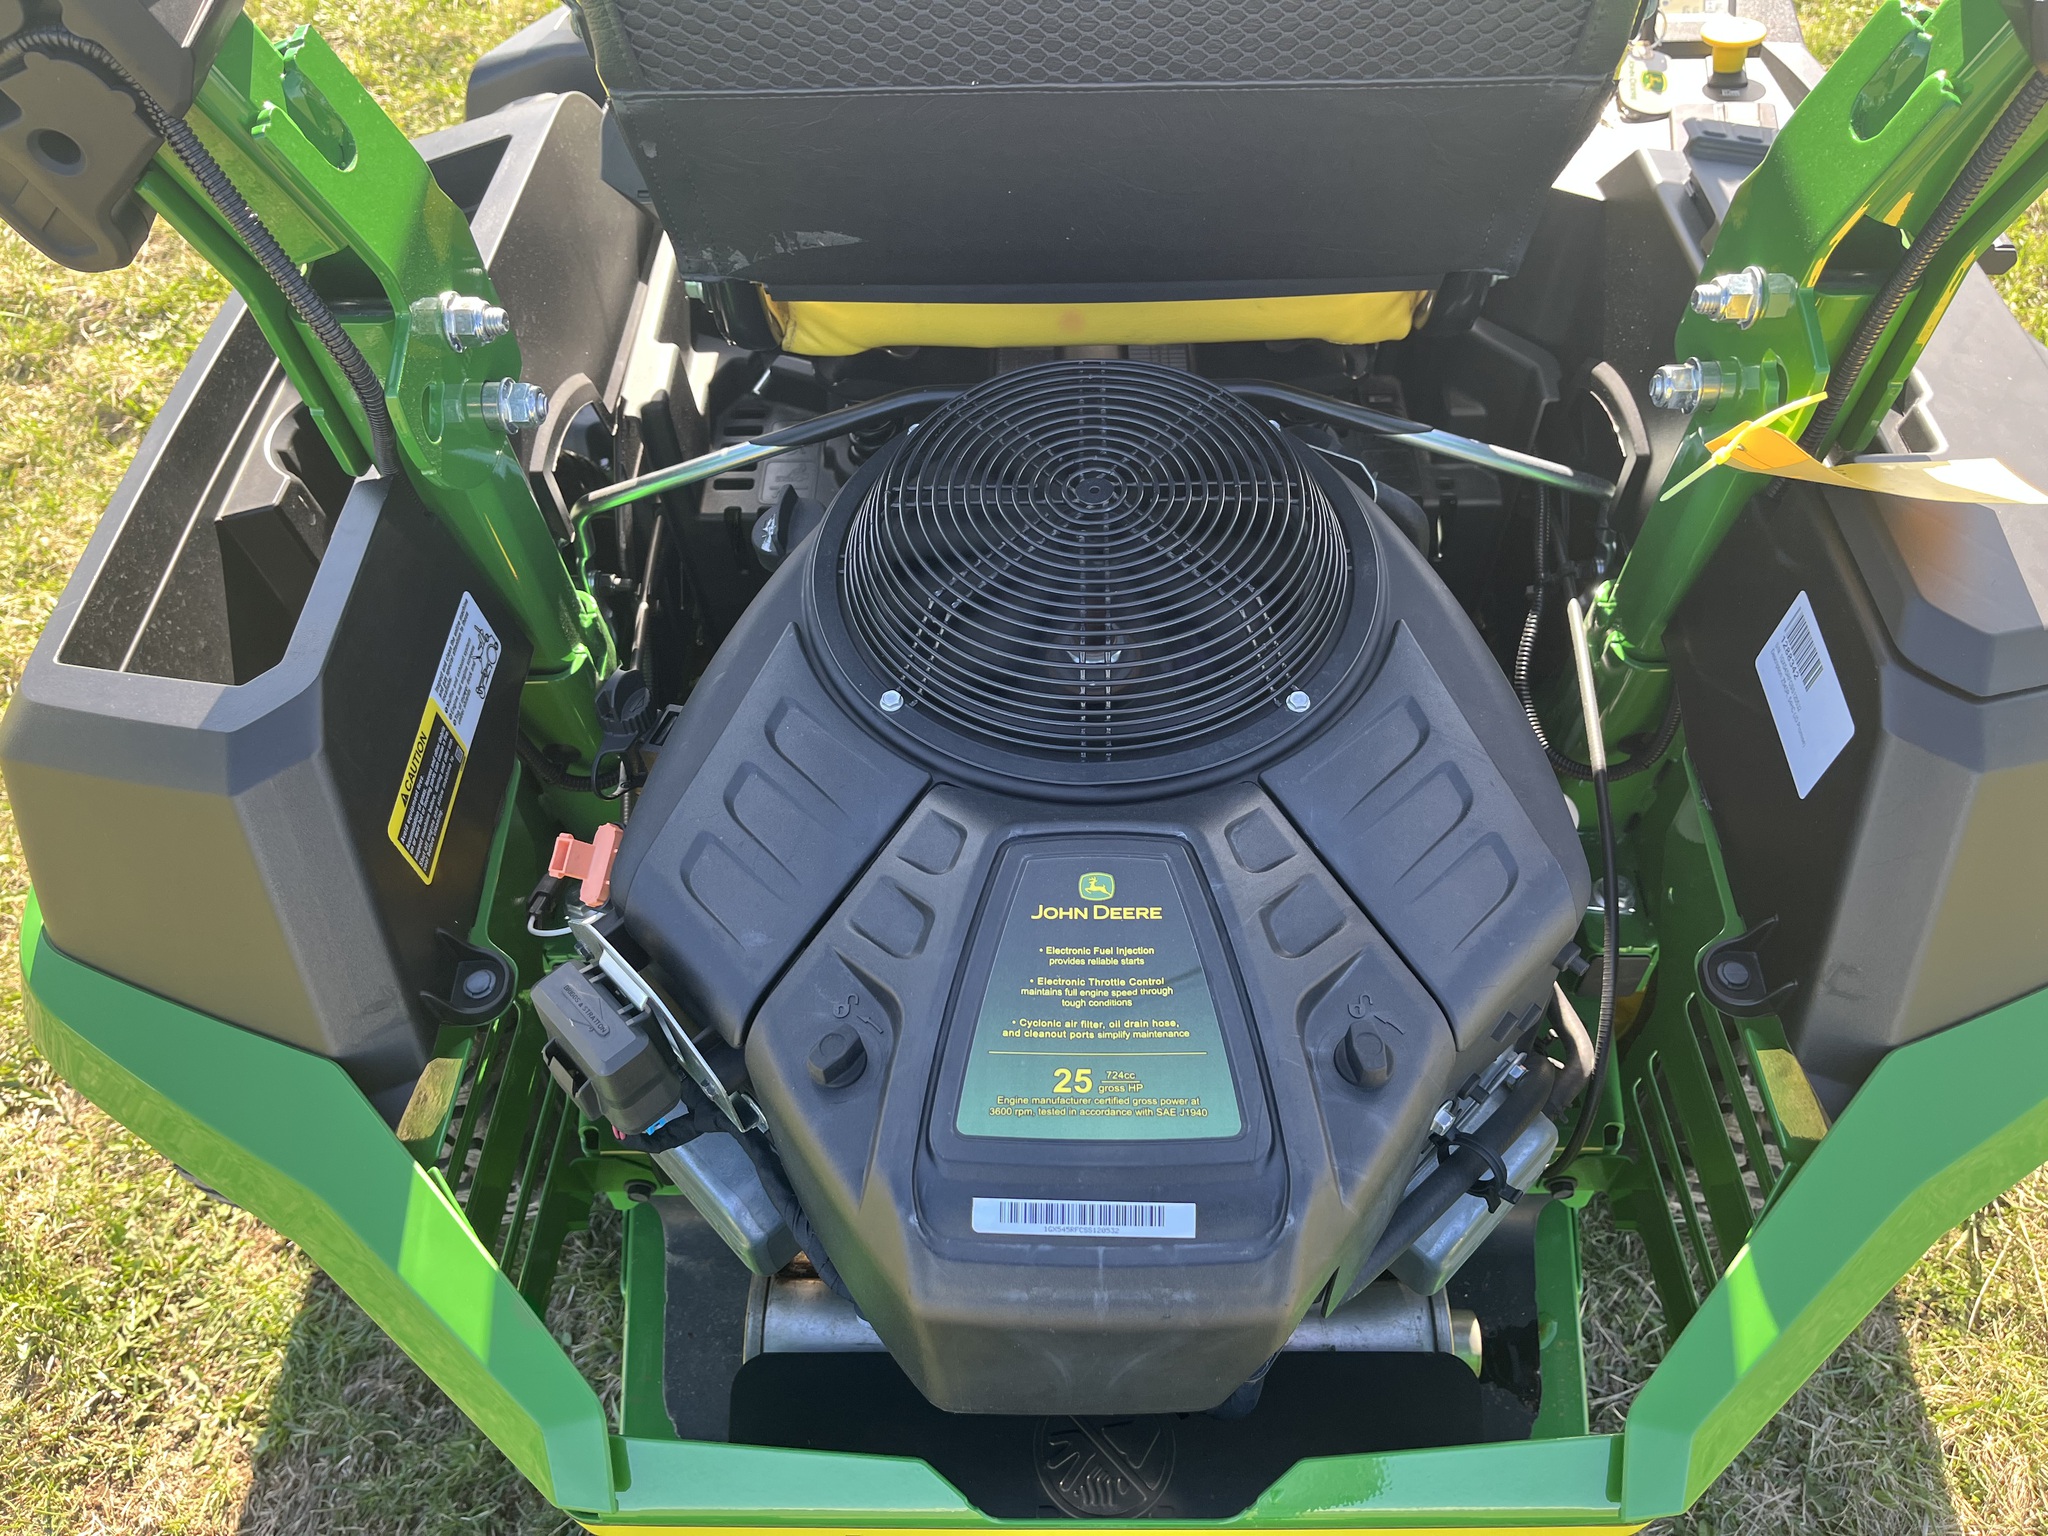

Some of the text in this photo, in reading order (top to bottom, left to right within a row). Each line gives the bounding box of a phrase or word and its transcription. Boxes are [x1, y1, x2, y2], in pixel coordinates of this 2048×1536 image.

[1781, 636, 1798, 679] 1288342
[405, 732, 426, 791] CAUTION
[400, 824, 408, 843] Avoid
[407, 790, 419, 824] equipment
[1031, 905, 1163, 920] JOHN DEERE
[1046, 947, 1154, 956] Electronic Fuel Injection
[1049, 958, 1085, 966] provides
[1037, 977, 1164, 986] Electronic Throttle Control
[1021, 987, 1173, 998] maintains full engine speed through
[1062, 999, 1086, 1008] tough
[582, 1006, 606, 1032] STRATTON
[1019, 1019, 1179, 1029] Cyclonic air filter, oil drain hose,
[1002, 1029, 1190, 1040] and cleanout ports simplify maintenance
[1106, 1071, 1135, 1079] 724cc
[1052, 1068, 1093, 1094] 25
[1098, 1084, 1143, 1094] gross HP
[997, 1096, 1029, 1106] Engine
[1032, 1097, 1091, 1105] manufacturer
[1094, 1097, 1129, 1105] certified
[1133, 1098, 1157, 1106] gross
[1160, 1098, 1188, 1106] power
[989, 1108, 1208, 1117] 3600 rpm, tested in accordance with SAE J1940
